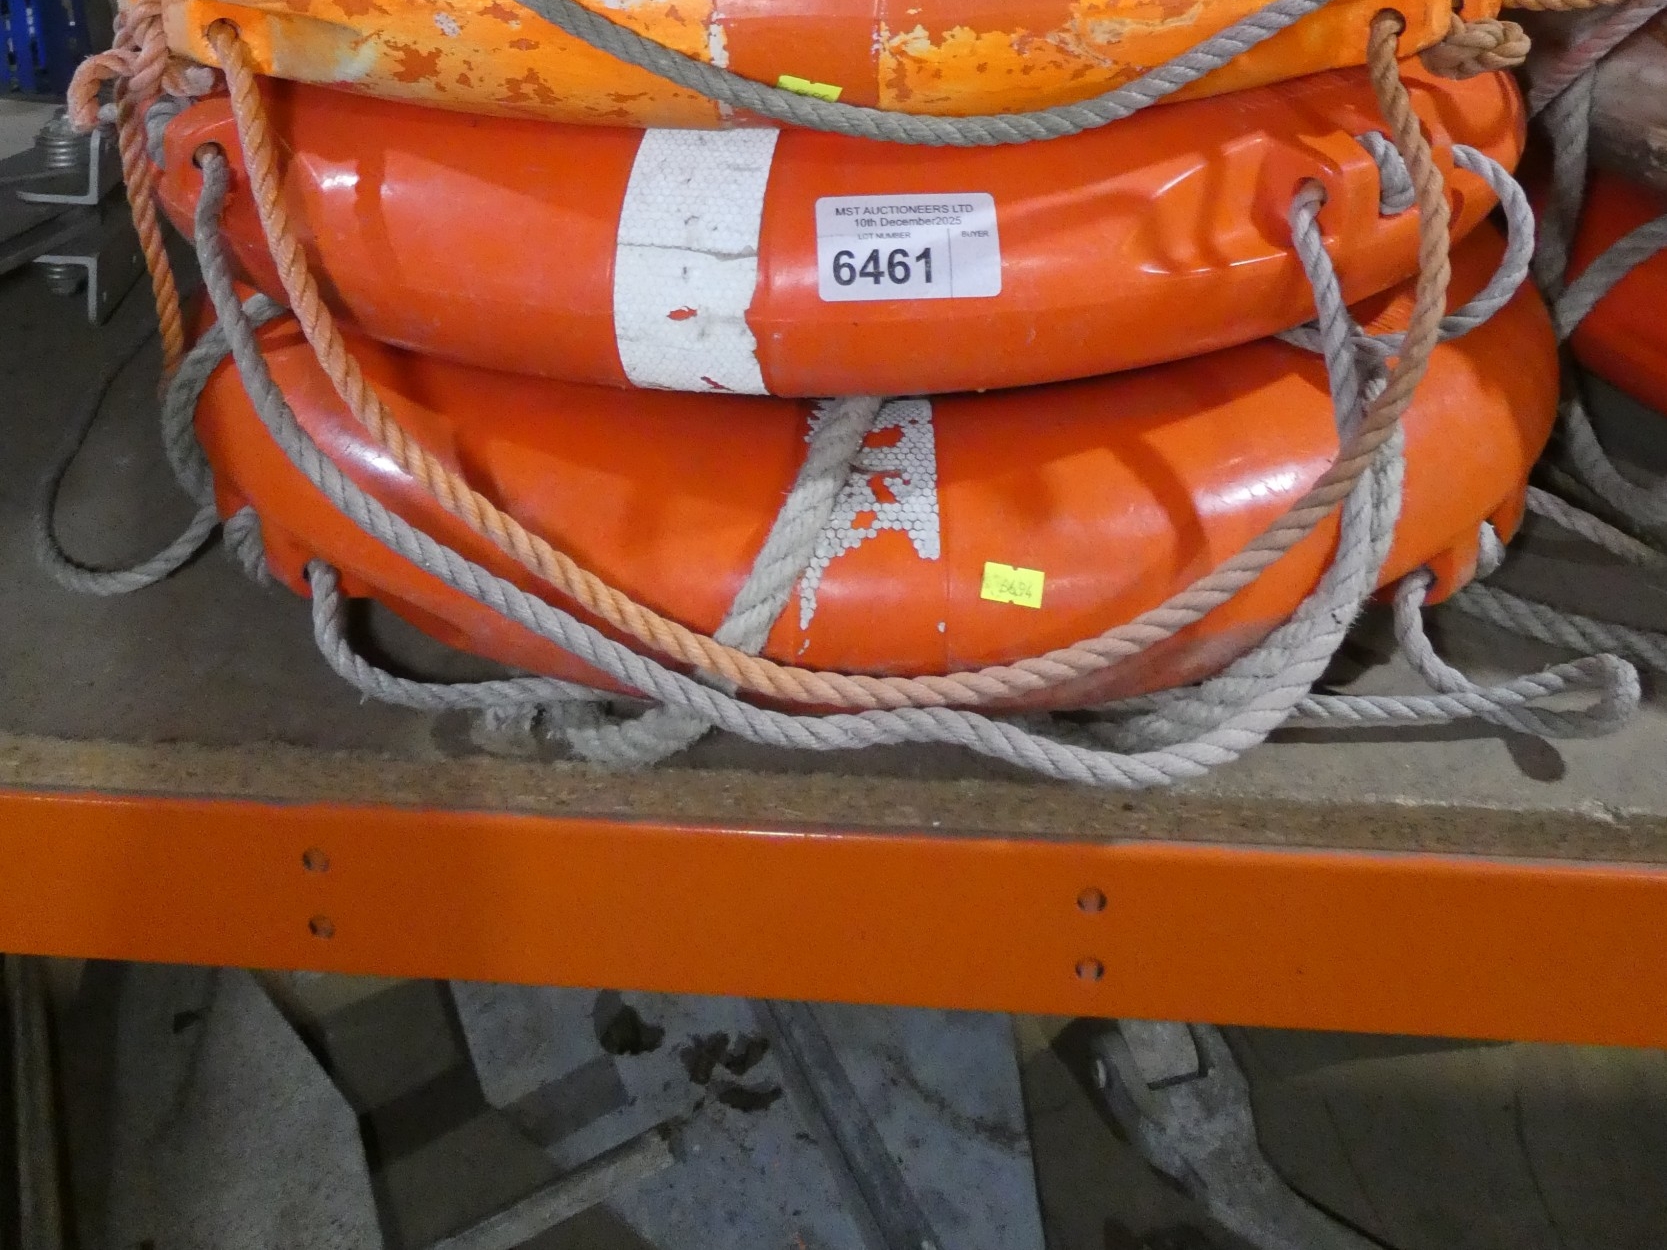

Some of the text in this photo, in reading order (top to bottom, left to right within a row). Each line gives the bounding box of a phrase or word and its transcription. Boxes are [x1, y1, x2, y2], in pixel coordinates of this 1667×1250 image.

[835, 203, 974, 216] MST AUCTIONEERS LTD
[854, 217, 877, 228] 10th
[857, 231, 911, 240] LOT NUMBER
[961, 230, 989, 238] BUYER
[832, 246, 933, 287] 6461
